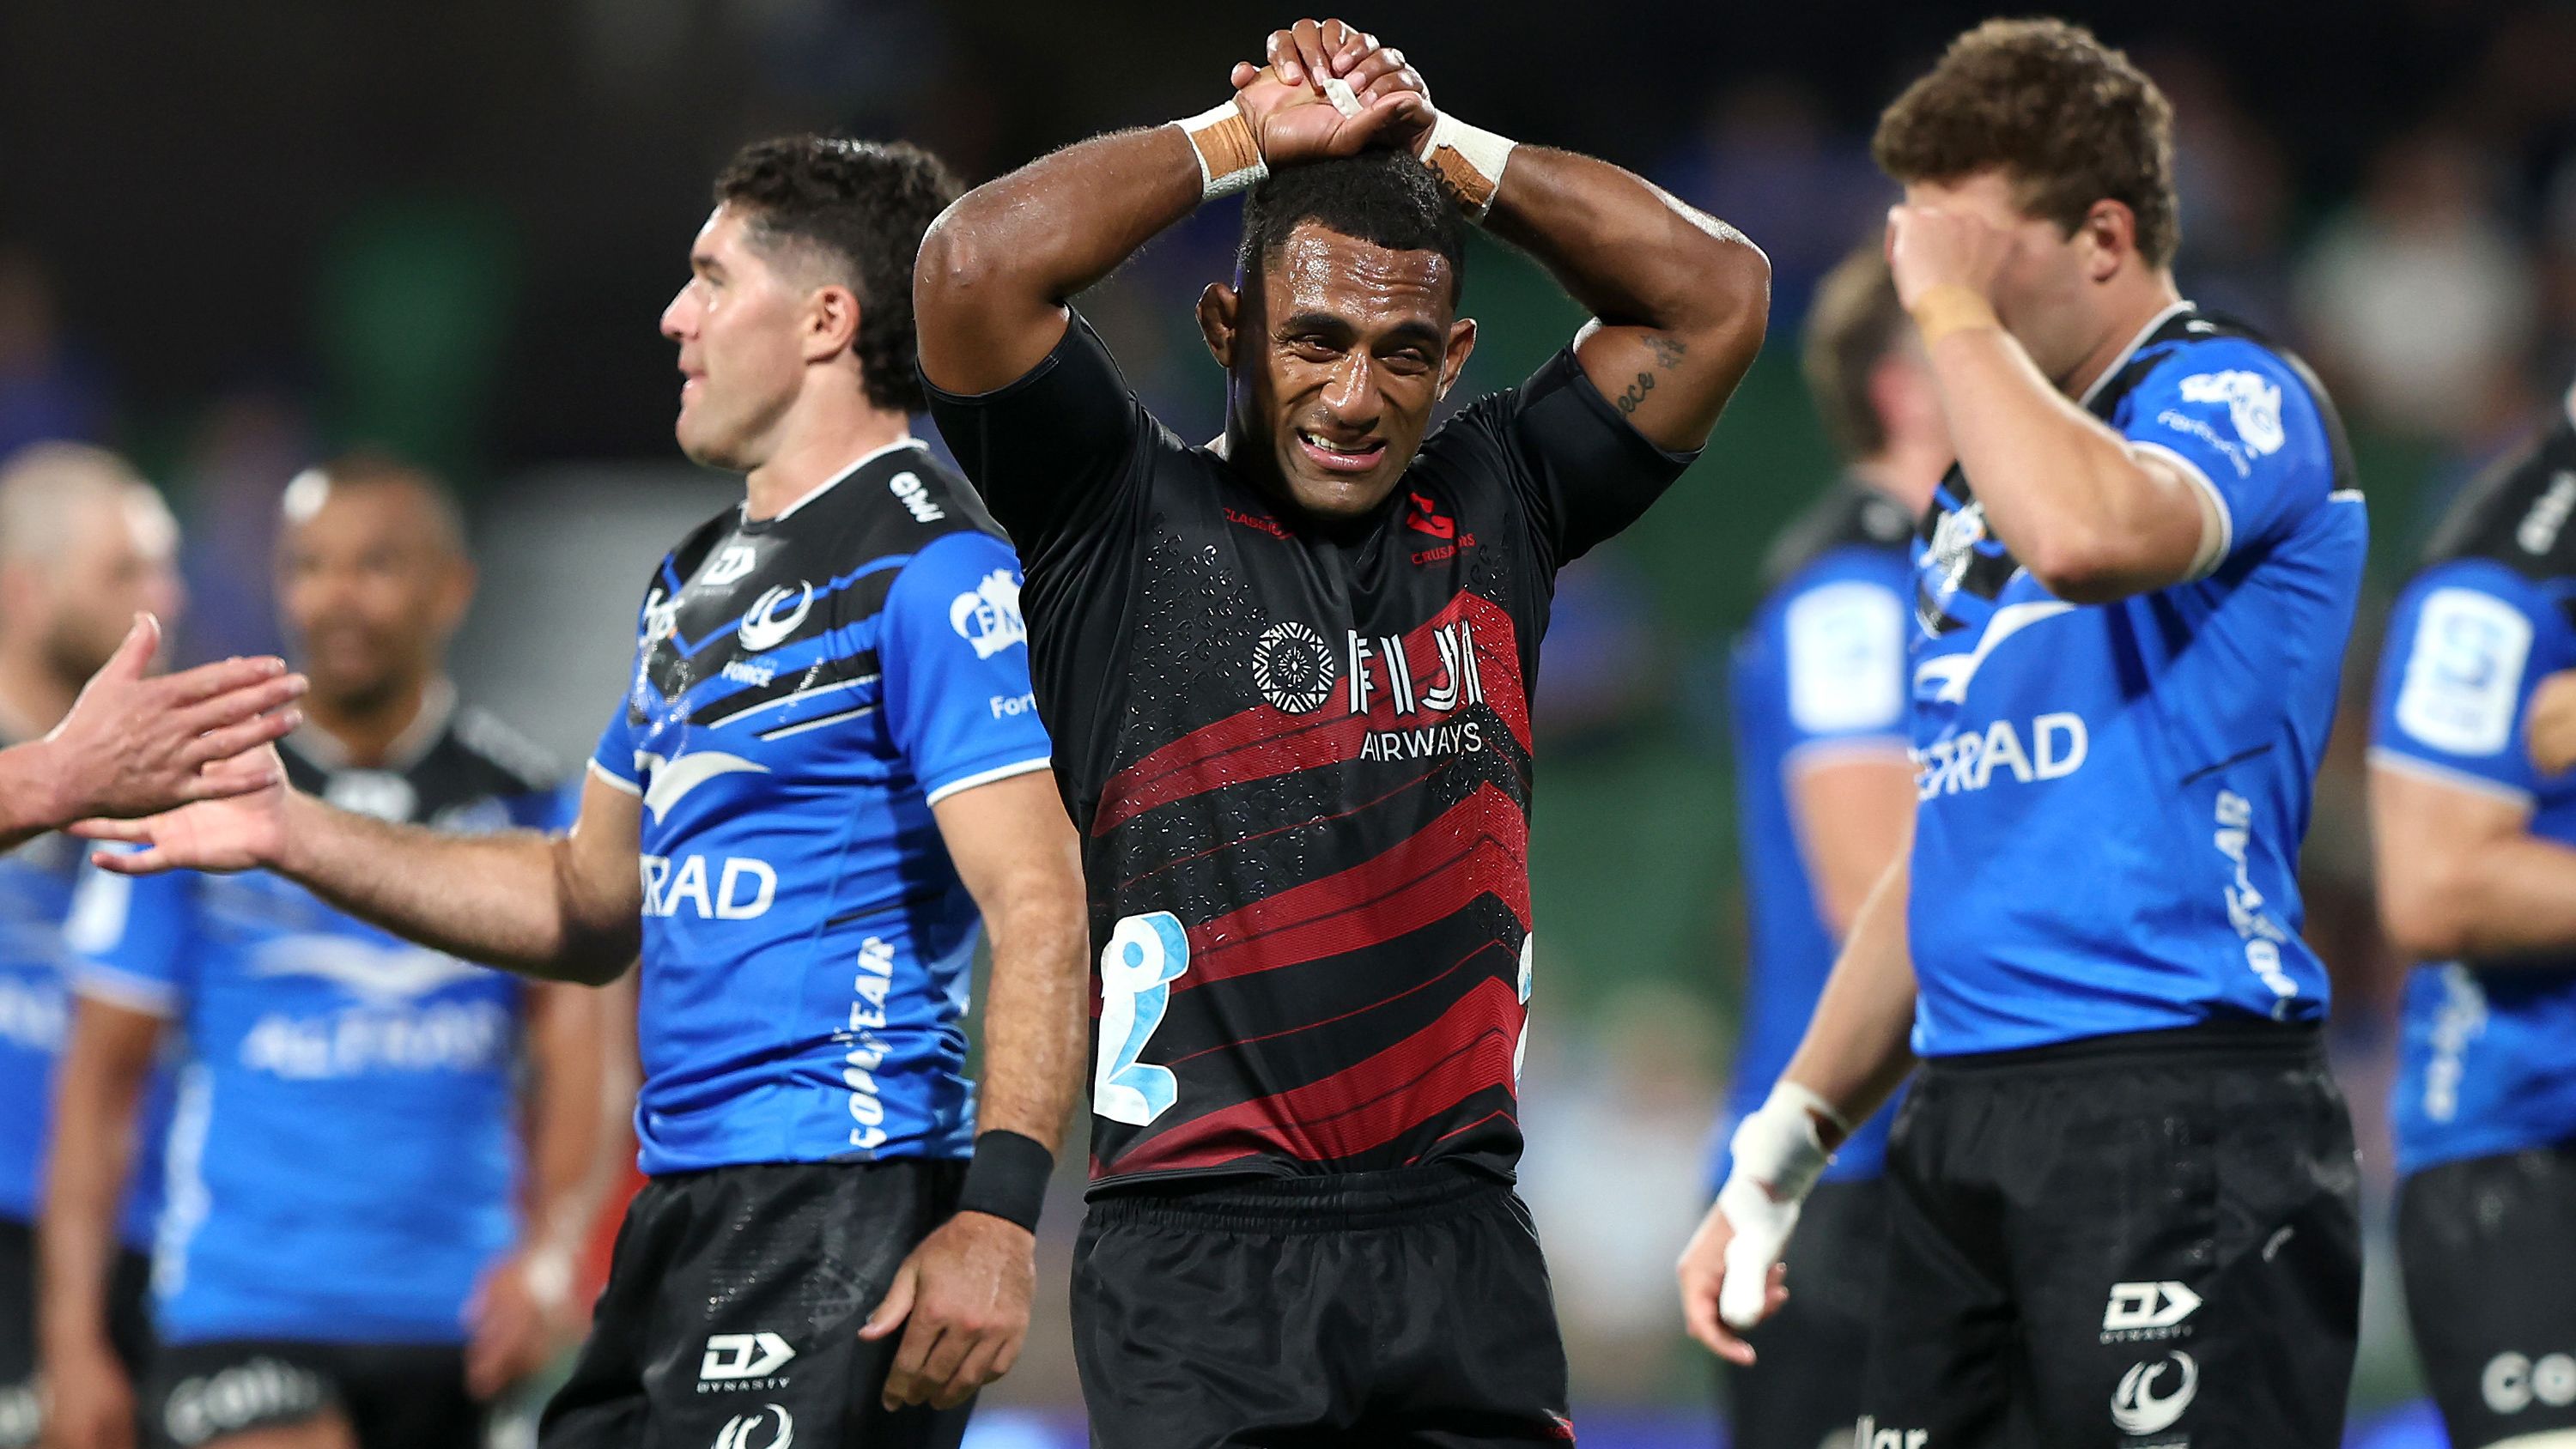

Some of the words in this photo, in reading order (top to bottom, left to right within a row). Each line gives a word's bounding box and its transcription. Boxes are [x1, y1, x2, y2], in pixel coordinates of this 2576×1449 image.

[1410, 532, 1477, 565] CRUSARS
[1347, 620, 1485, 716] FIJI
[1360, 722, 1482, 762] AIRWAYS
[696, 1376, 791, 1394] DYNASTY
